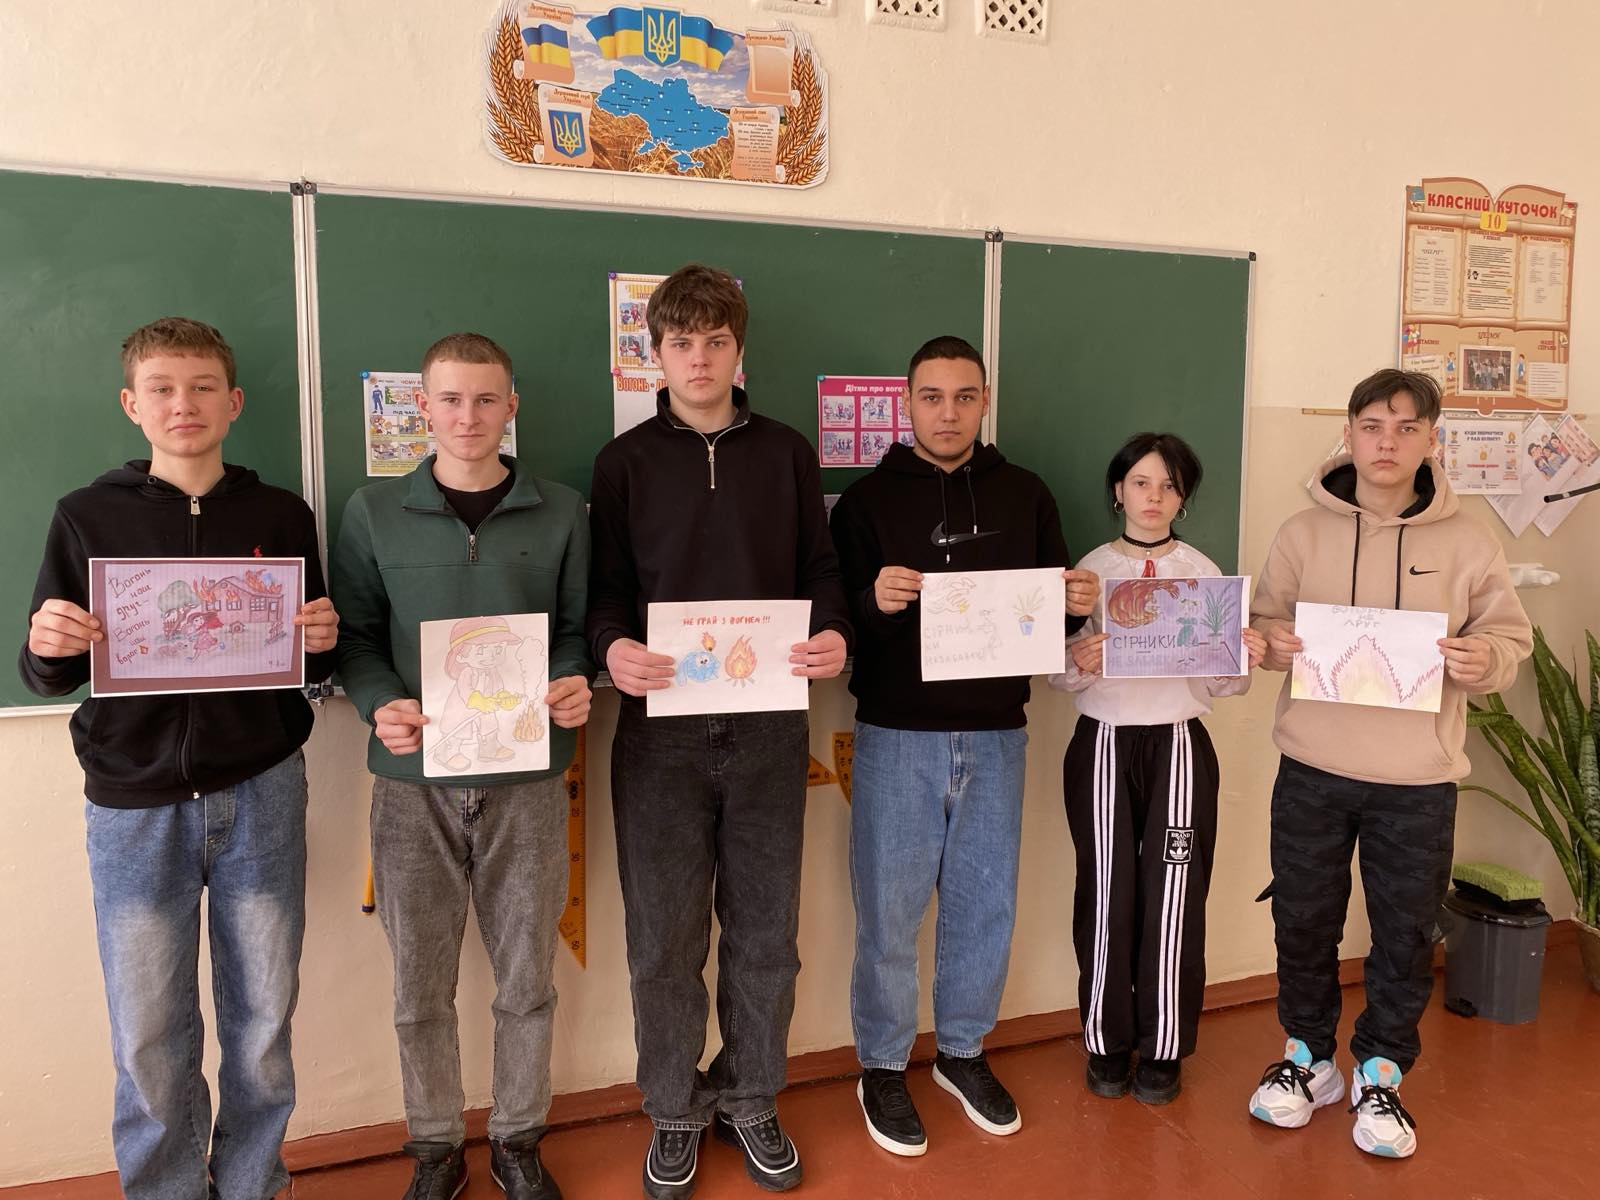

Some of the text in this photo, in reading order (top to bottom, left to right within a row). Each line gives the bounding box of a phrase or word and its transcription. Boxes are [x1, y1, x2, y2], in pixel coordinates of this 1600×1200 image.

[1427, 192, 1558, 219] КЛАСНИЙ КУТОЧОК
[1486, 213, 1502, 230] 10
[845, 384, 868, 393] Дітям
[869, 386, 884, 394] про
[683, 617, 694, 626] НЕ
[697, 615, 717, 626] ГРАЙ
[1112, 634, 1176, 649] СІРНИКИ
[571, 807, 580, 817] 20
[571, 852, 580, 862] 30
[571, 940, 580, 950] 50
